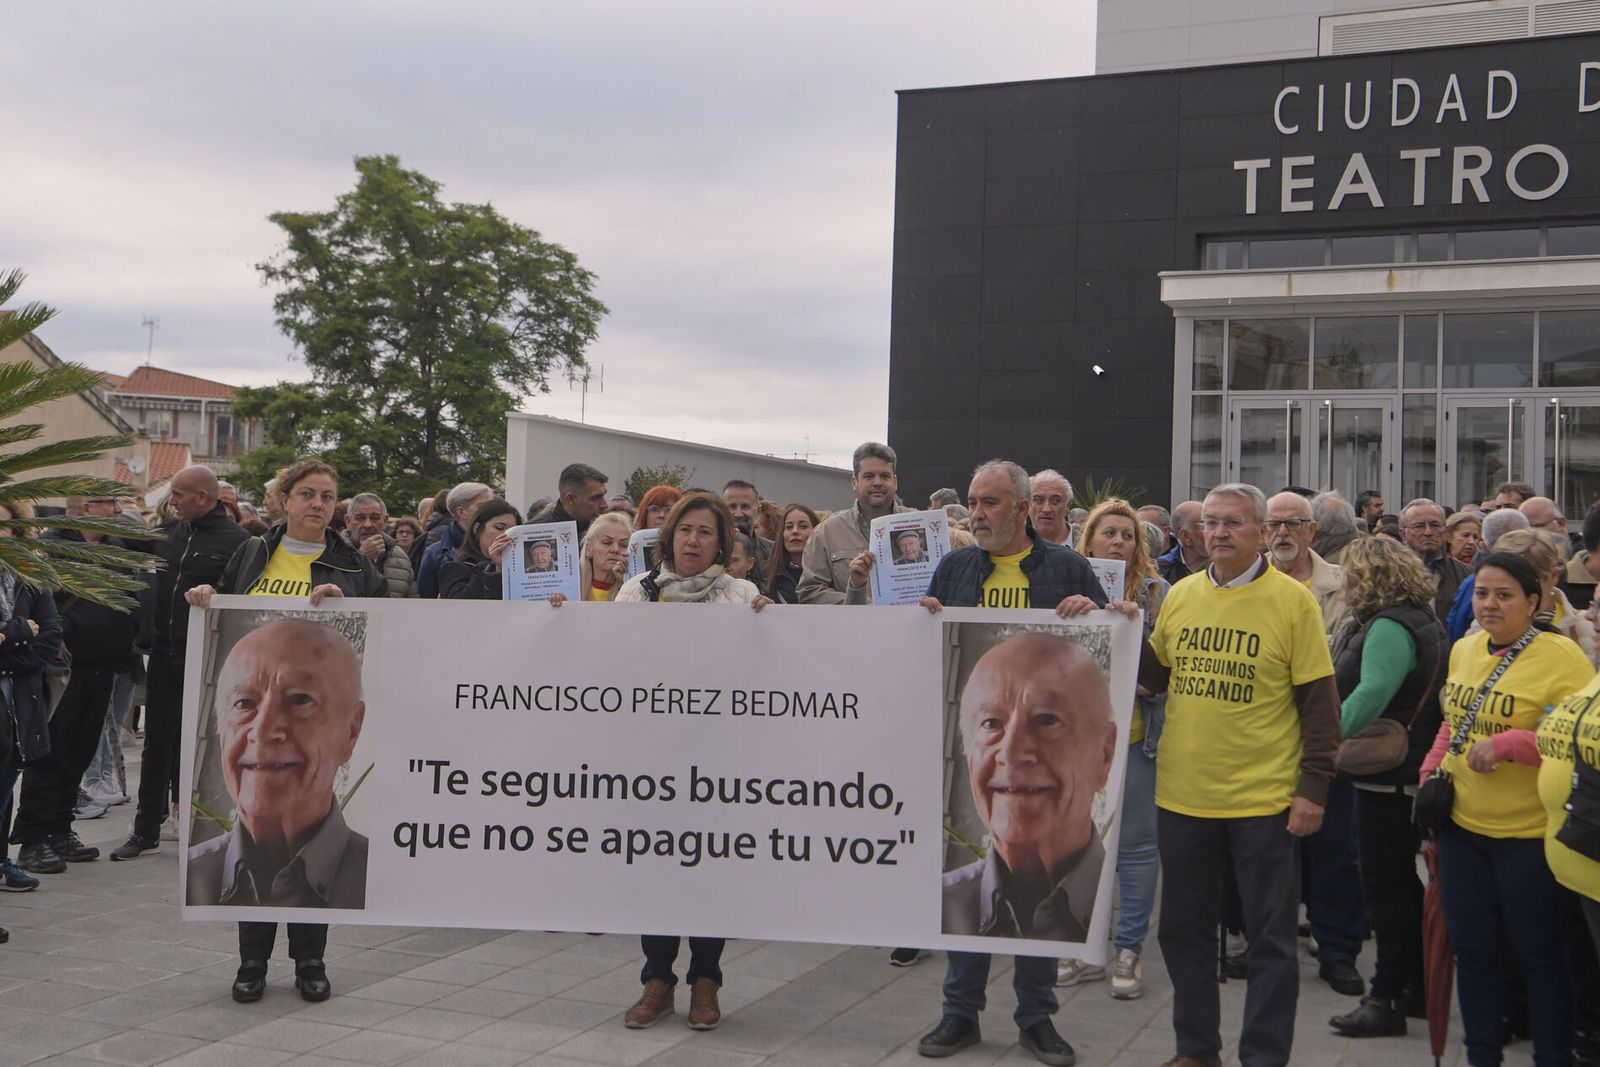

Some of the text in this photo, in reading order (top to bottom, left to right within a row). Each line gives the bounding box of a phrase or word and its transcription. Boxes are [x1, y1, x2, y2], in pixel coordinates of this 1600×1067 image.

[1274, 70, 1518, 135] CIUDAD
[1234, 143, 1569, 215] TEATRO
[1176, 626, 1260, 658] PAQUITO
[1175, 656, 1256, 680] TE SEGUIMOS
[456, 683, 858, 719] FRANCISCO PÉREZ BEDMAR
[410, 759, 903, 816] "Te seguimos buscando,
[394, 822, 915, 867] que no se apague tu voz"
